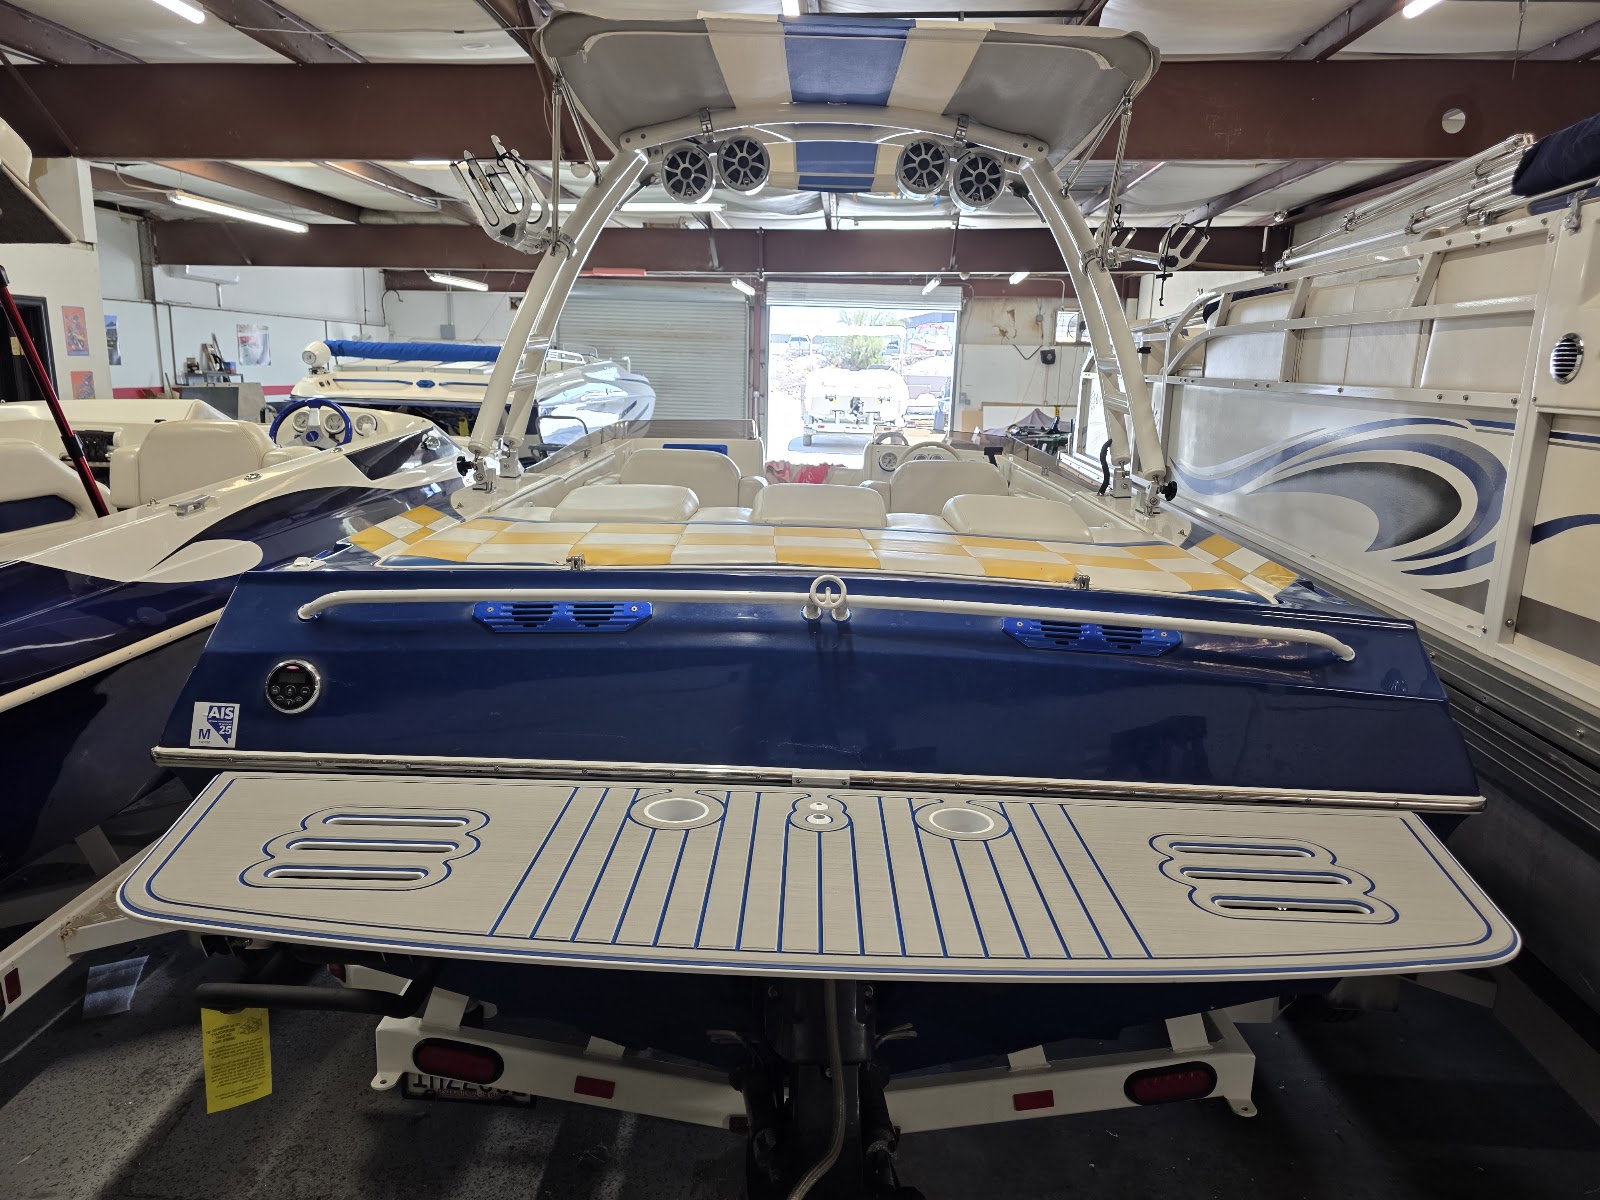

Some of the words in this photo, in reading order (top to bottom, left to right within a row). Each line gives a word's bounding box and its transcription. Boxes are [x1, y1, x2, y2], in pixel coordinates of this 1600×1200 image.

[208, 707, 234, 719] AIS
[199, 729, 211, 739] M
[219, 726, 231, 734] 25
